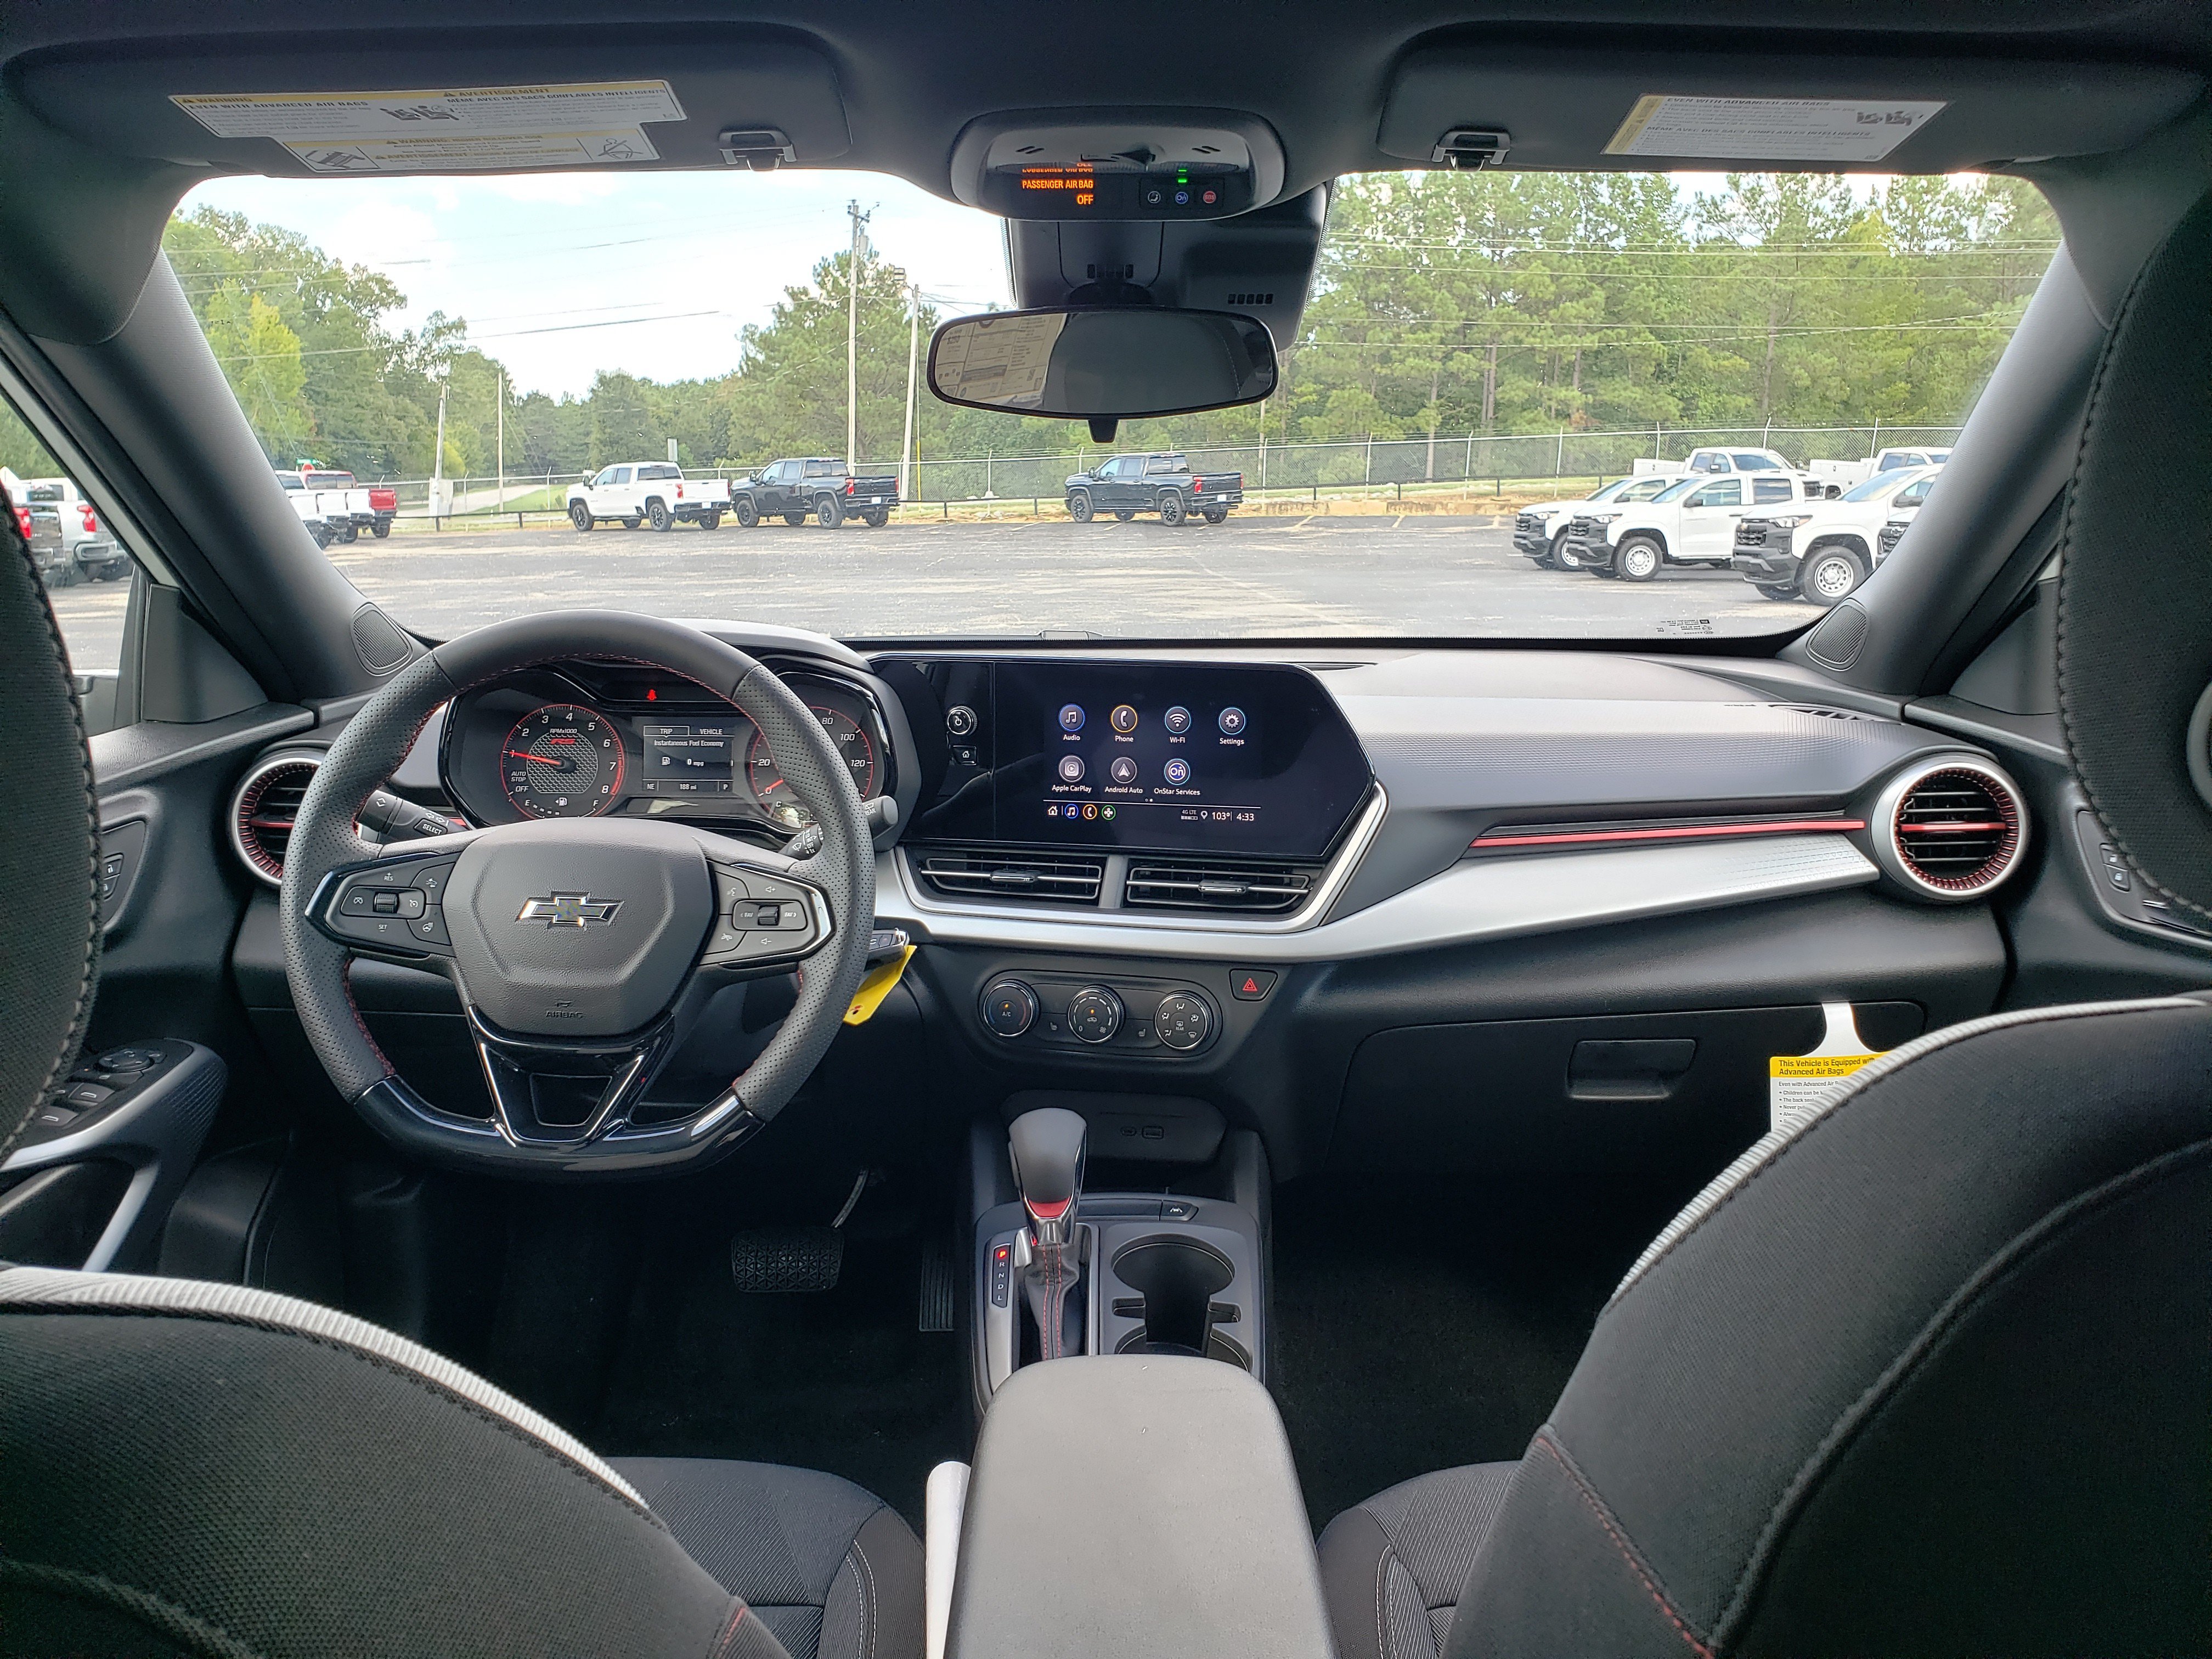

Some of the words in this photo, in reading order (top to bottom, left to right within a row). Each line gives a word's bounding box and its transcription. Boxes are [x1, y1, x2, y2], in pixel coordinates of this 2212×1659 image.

[1022, 179, 1064, 189] PASSENGER
[1065, 179, 1078, 189] AIR
[1078, 179, 1094, 189] BAG
[1077, 194, 1094, 205] OFF
[541, 715, 549, 724] 3
[566, 713, 573, 721] 4
[588, 722, 595, 730] 5
[522, 728, 529, 737] 2
[1220, 738, 1244, 746] Settings
[610, 762, 616, 770] 7
[602, 785, 609, 793] 8
[1070, 785, 1092, 793] CarPlay
[1236, 813, 1254, 821] 4:33
[422, 823, 442, 836] SELECT
[1831, 1058, 1860, 1067] Equipped
[1827, 1068, 1844, 1076] Bags
